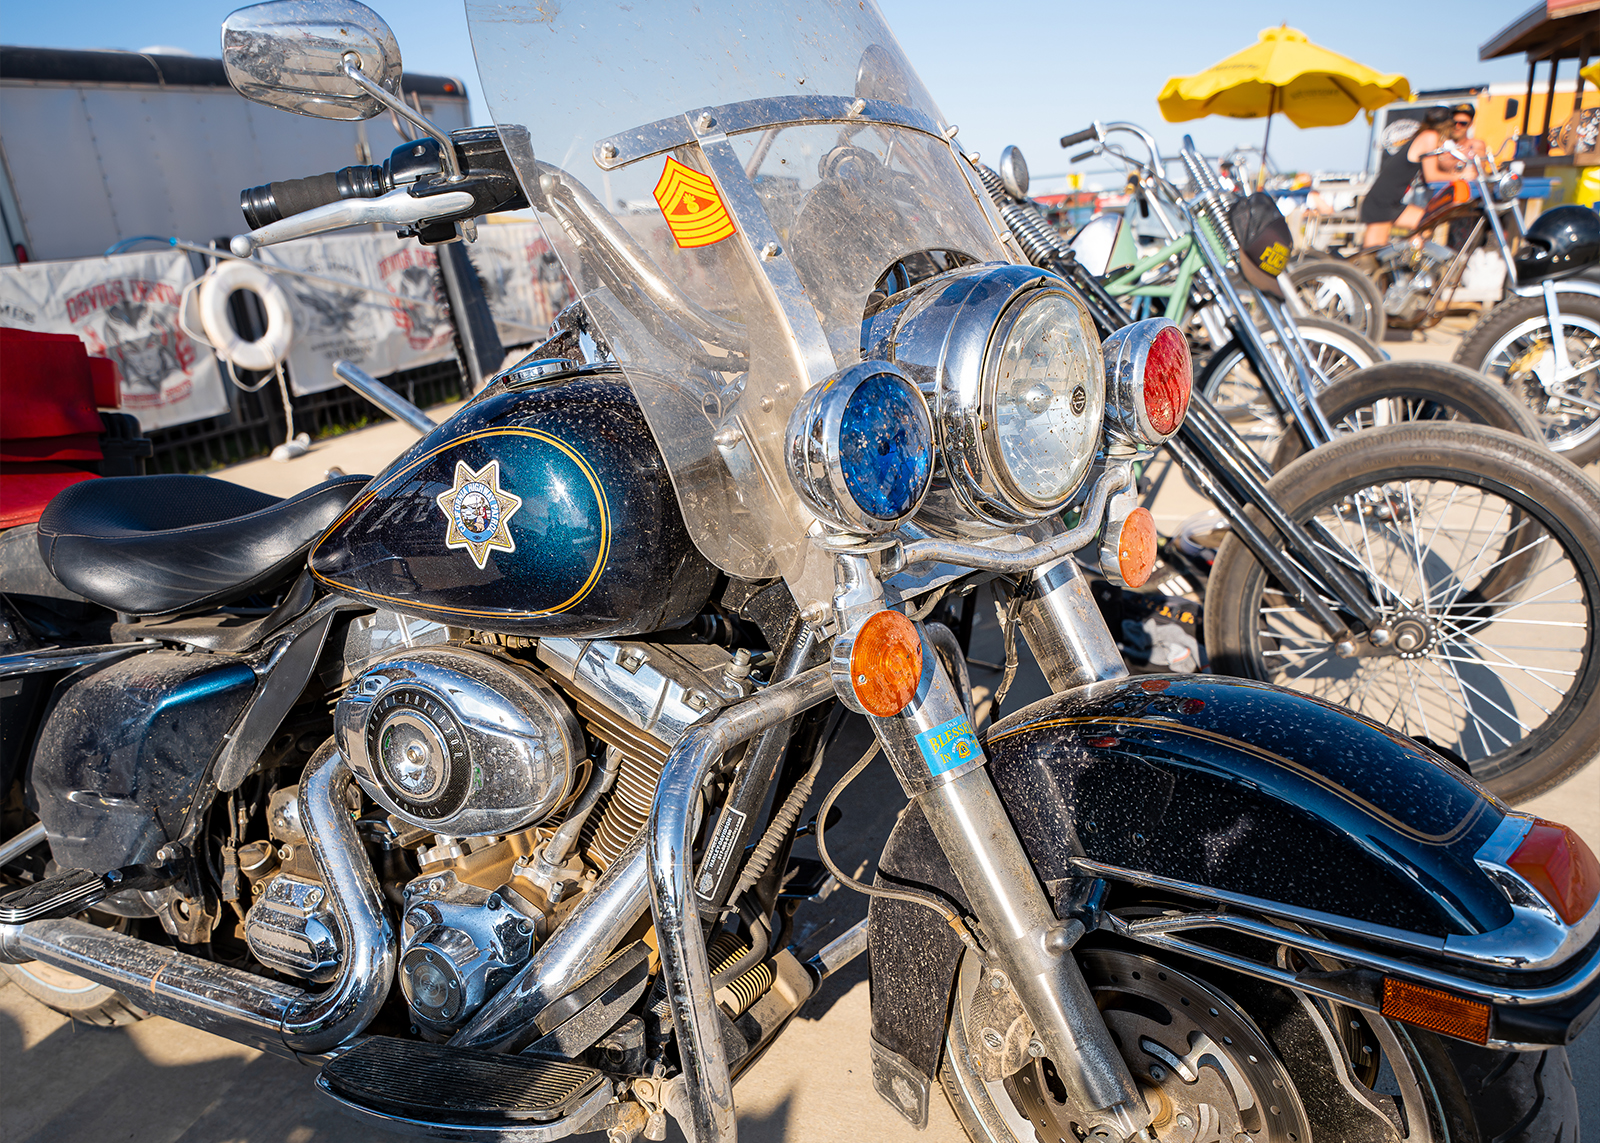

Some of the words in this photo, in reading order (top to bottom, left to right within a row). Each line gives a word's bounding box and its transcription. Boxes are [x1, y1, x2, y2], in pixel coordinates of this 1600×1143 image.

[468, 483, 495, 503] HIGHWAY
[487, 503, 499, 534] PATROL
[395, 797, 441, 817] POLICE
